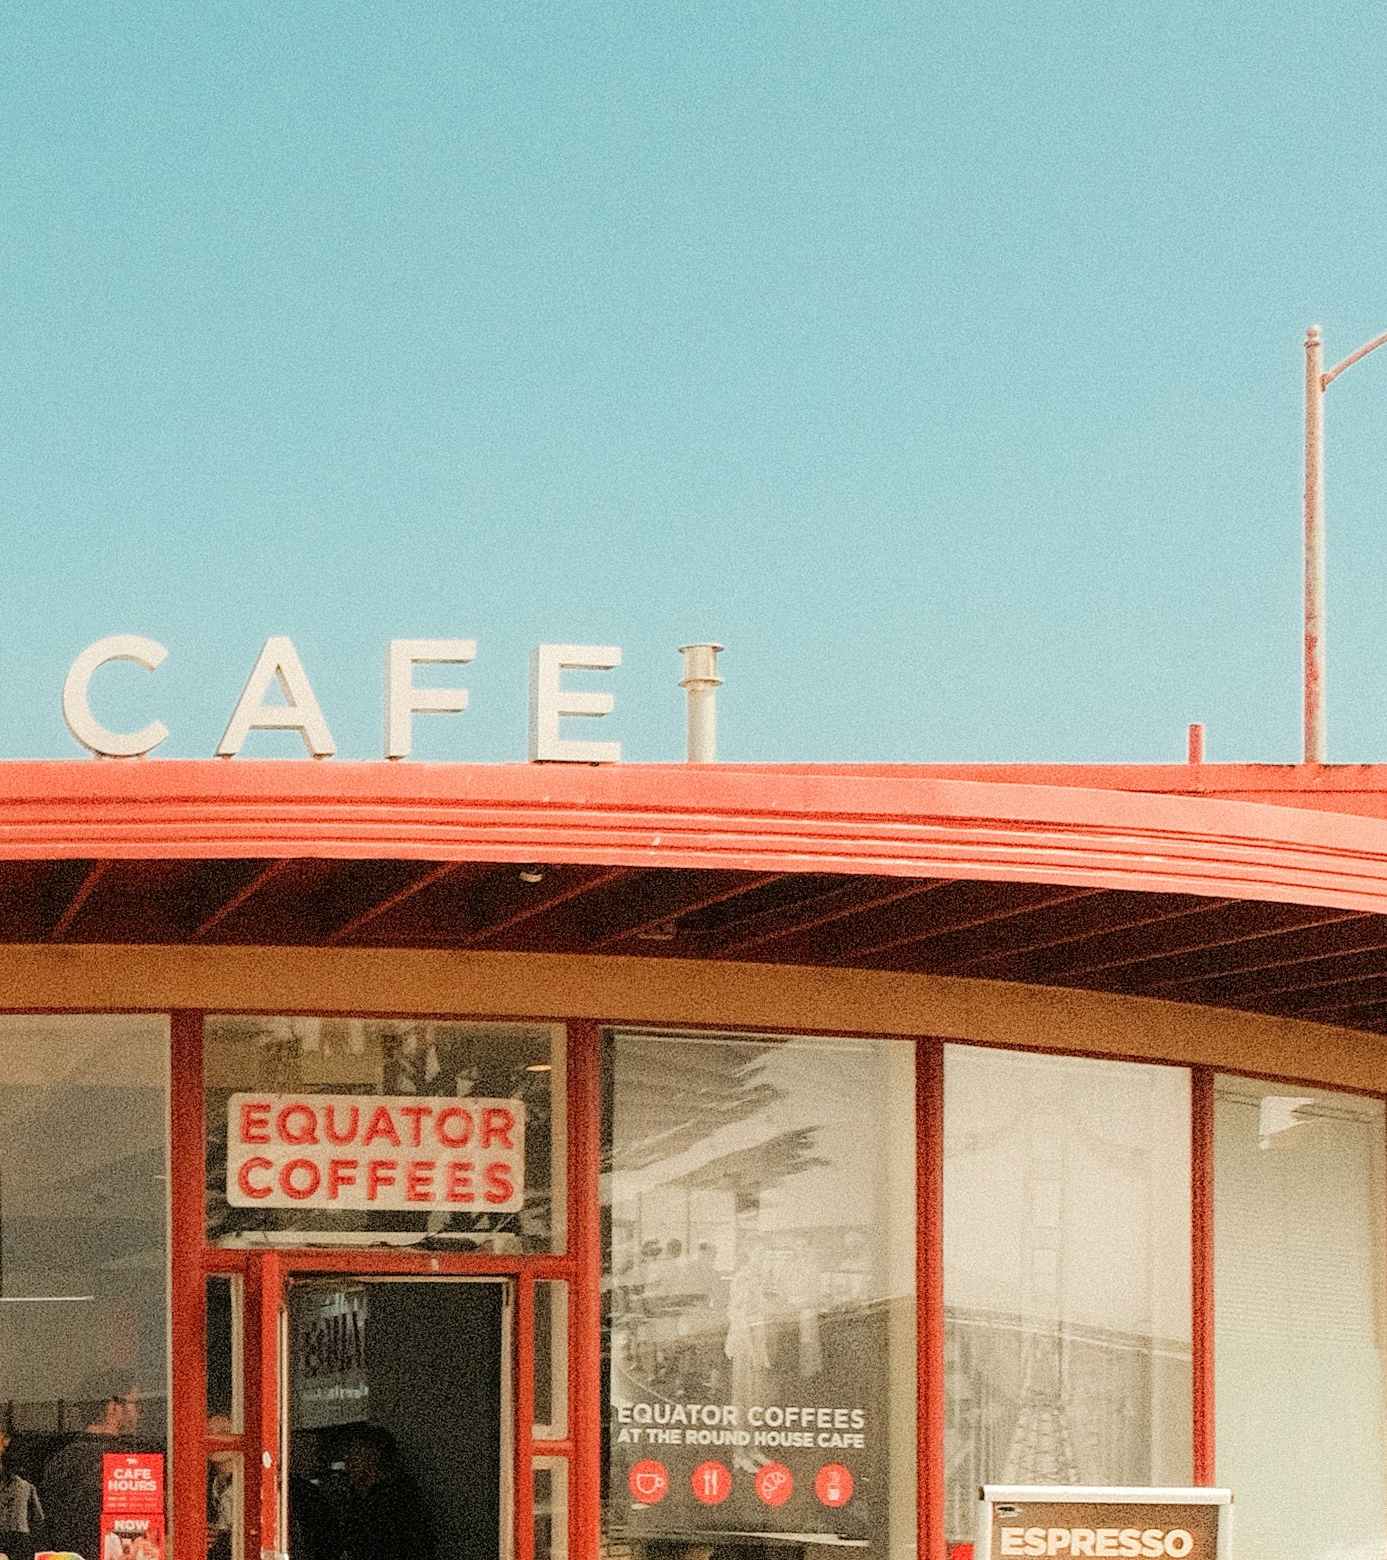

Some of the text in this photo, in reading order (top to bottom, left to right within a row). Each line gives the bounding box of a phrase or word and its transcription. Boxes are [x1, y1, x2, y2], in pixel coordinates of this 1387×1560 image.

[61, 633, 623, 764] CAFE
[240, 1102, 516, 1149] EQUATOR
[237, 1156, 515, 1204] COFFEES
[617, 1403, 865, 1430] EQUATOR COFFEES
[617, 1428, 865, 1448] AT THE ROUND HOUSE CAFE
[108, 1479, 158, 1492] HOURS
[113, 1467, 152, 1480] CAFE
[114, 1519, 150, 1531] NOW
[1000, 1526, 1194, 1558] ESPRESSO
